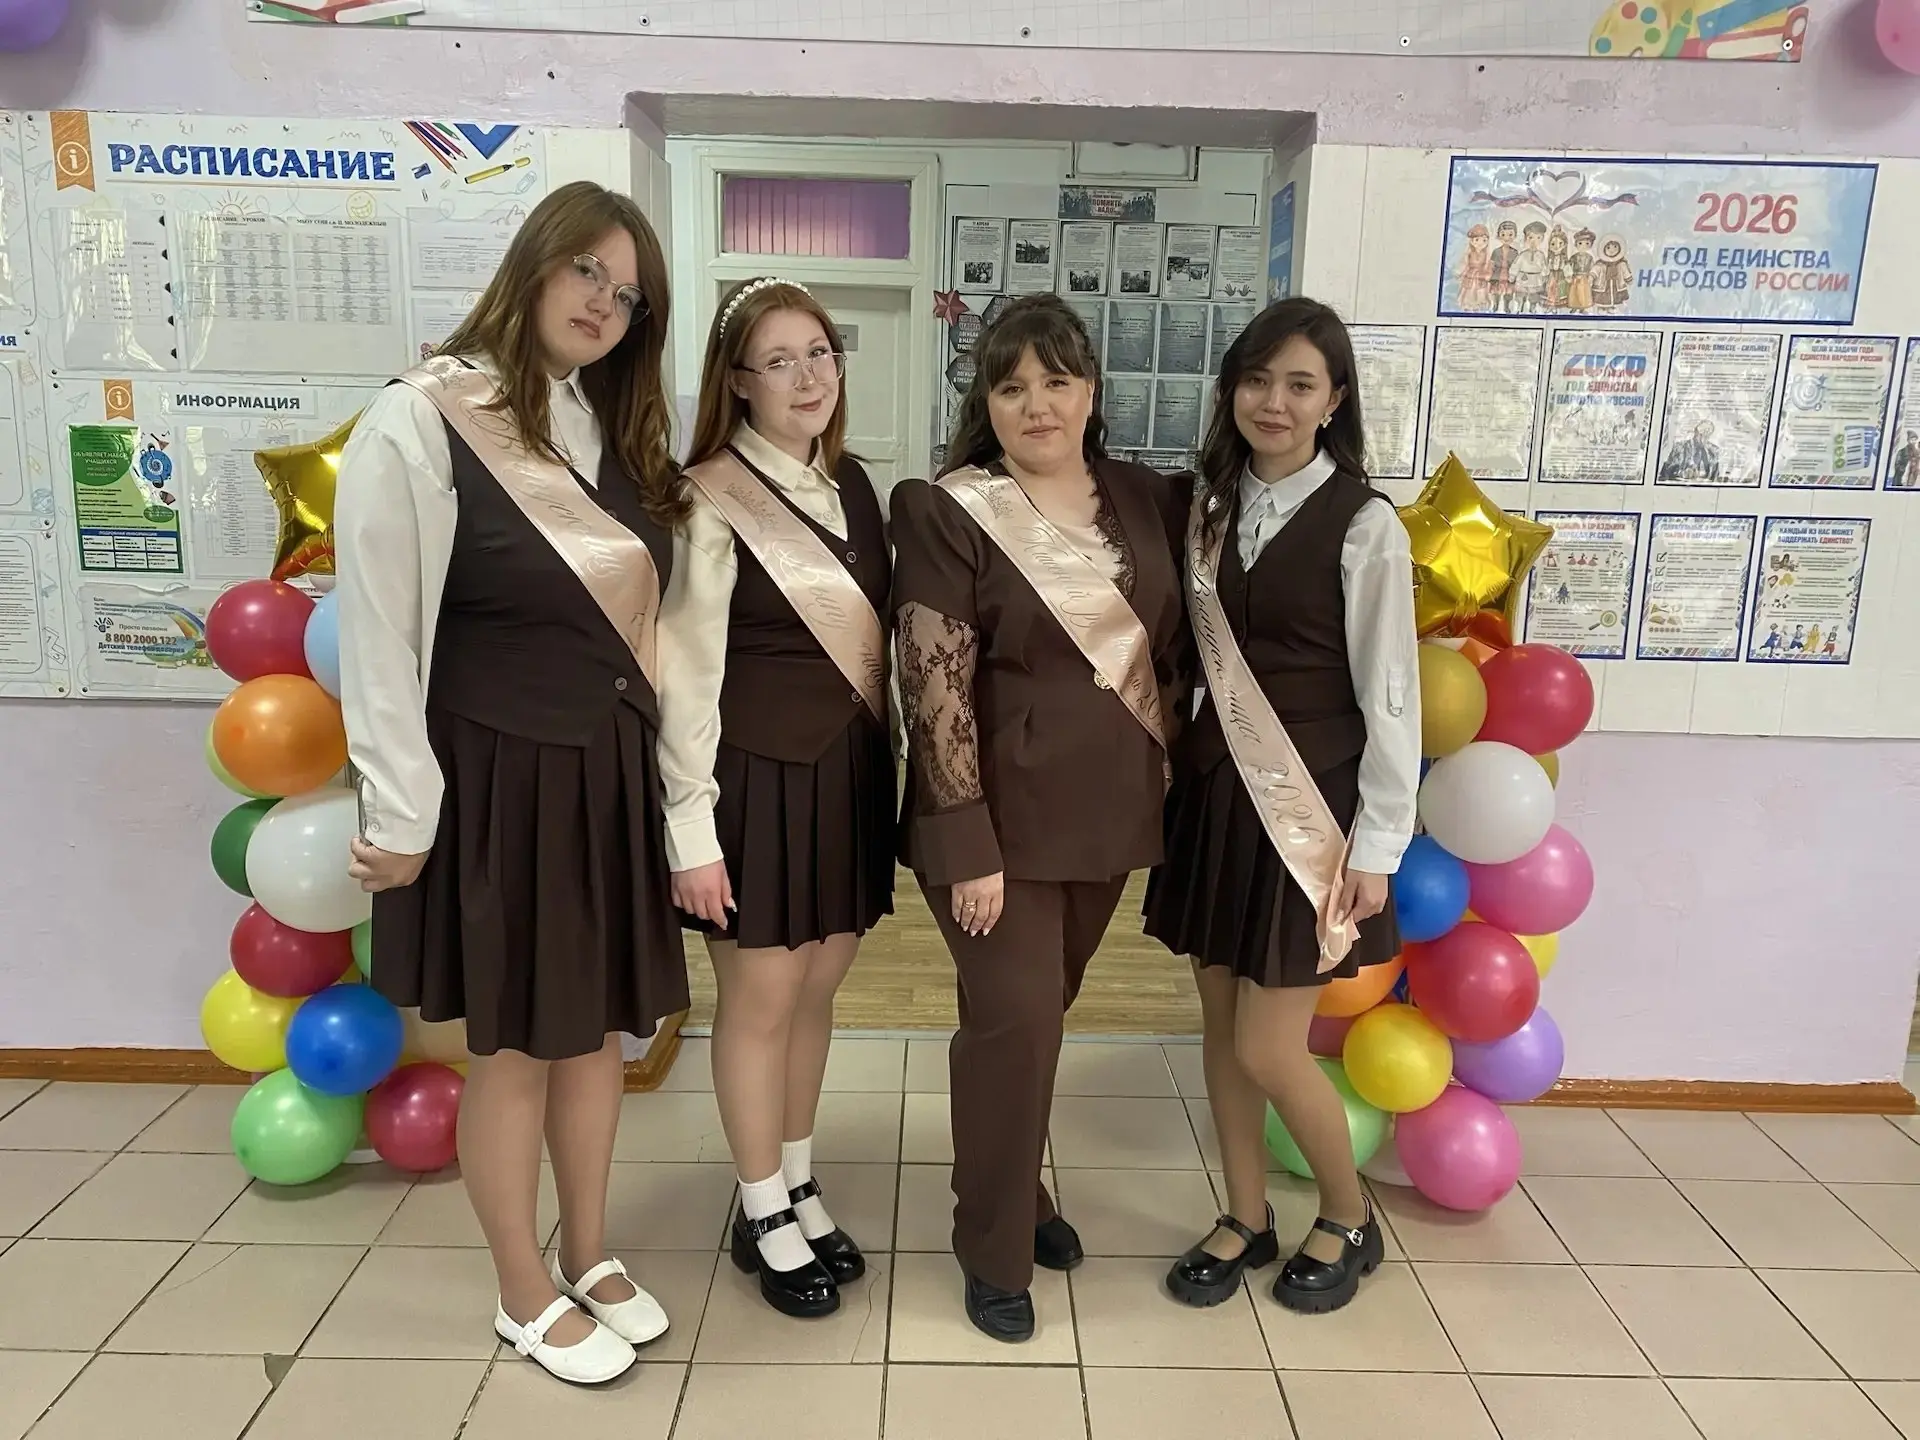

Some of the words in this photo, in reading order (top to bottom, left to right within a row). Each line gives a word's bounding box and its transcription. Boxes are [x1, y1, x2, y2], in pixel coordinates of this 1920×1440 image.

[107, 143, 396, 181] РАСПИСАНИЕ
[1693, 192, 1799, 235] 2026
[1662, 247, 1708, 269] ГОД
[1716, 248, 1831, 270] ЕДИНСТВА
[1637, 268, 1747, 293] НАРОДОВ
[1754, 271, 1850, 293] РОССИИ
[176, 394, 301, 411] ИНФОРМАЦИЯ
[1006, 526, 1094, 601] Классный
[105, 633, 112, 642] 8
[114, 632, 132, 643] 800
[134, 634, 157, 645] 2000
[159, 636, 177, 646] 122
[119, 623, 140, 631] Просто
[98, 641, 126, 651] Детский
[126, 644, 154, 653] телефон
[155, 646, 185, 654] доверия
[1190, 547, 1263, 744] Выпускница
[1249, 761, 1327, 844] 2026
